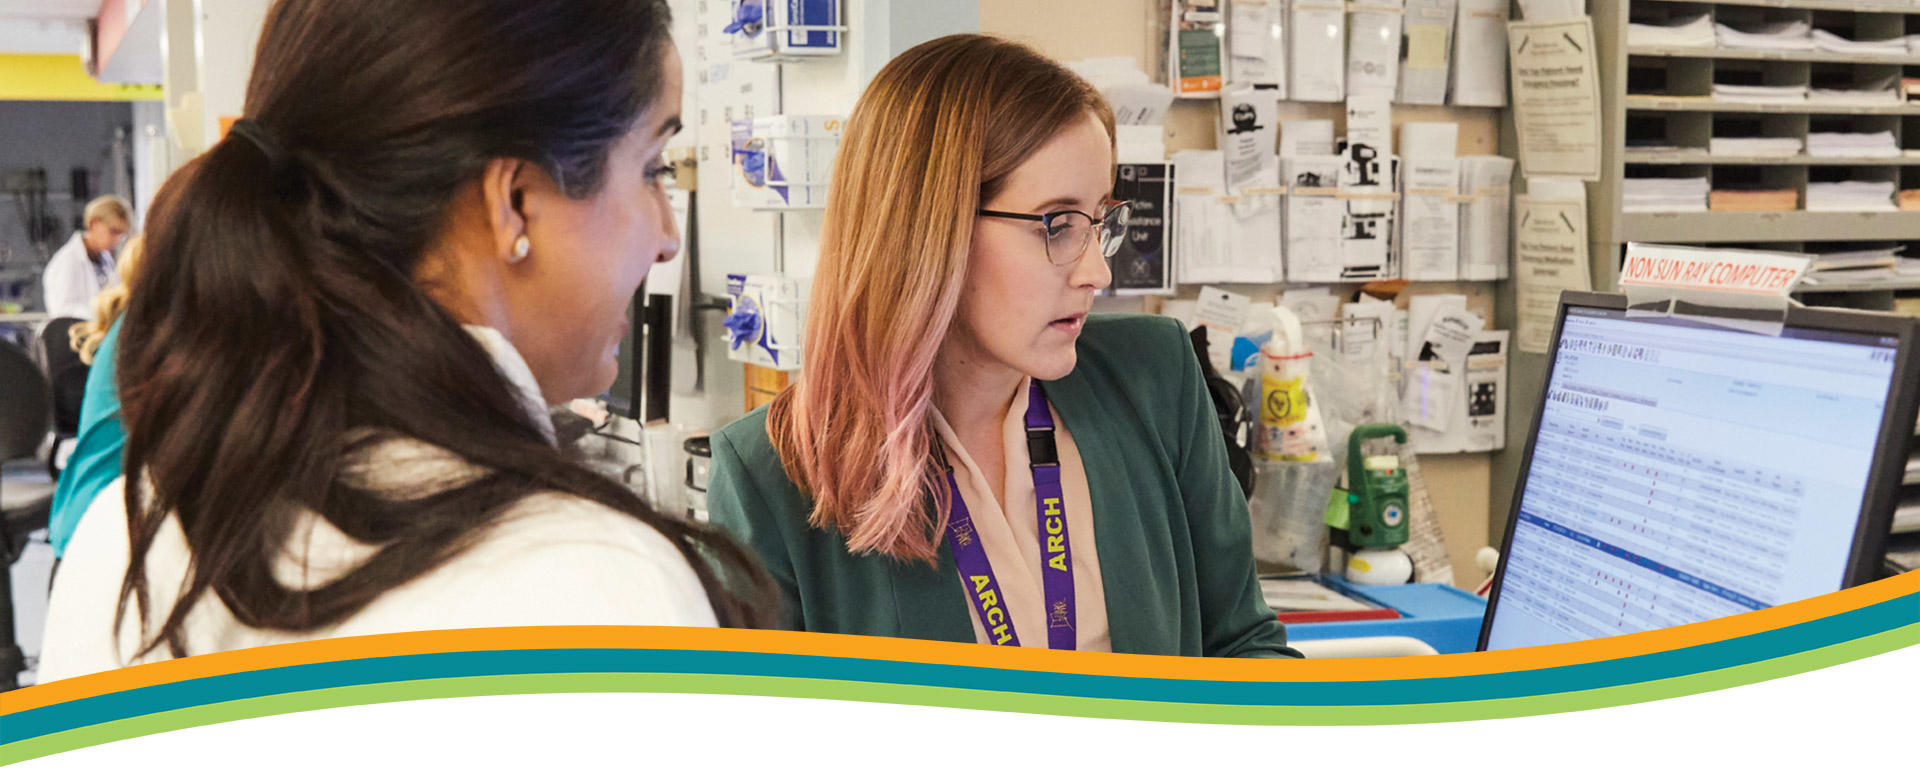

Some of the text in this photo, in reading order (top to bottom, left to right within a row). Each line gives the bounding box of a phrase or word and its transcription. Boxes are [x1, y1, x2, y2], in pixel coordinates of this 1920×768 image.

[1625, 256, 1797, 289] NON SUN RAY COMPUTER
[1043, 497, 1068, 572] ARCH
[969, 574, 1013, 646] ARCH
